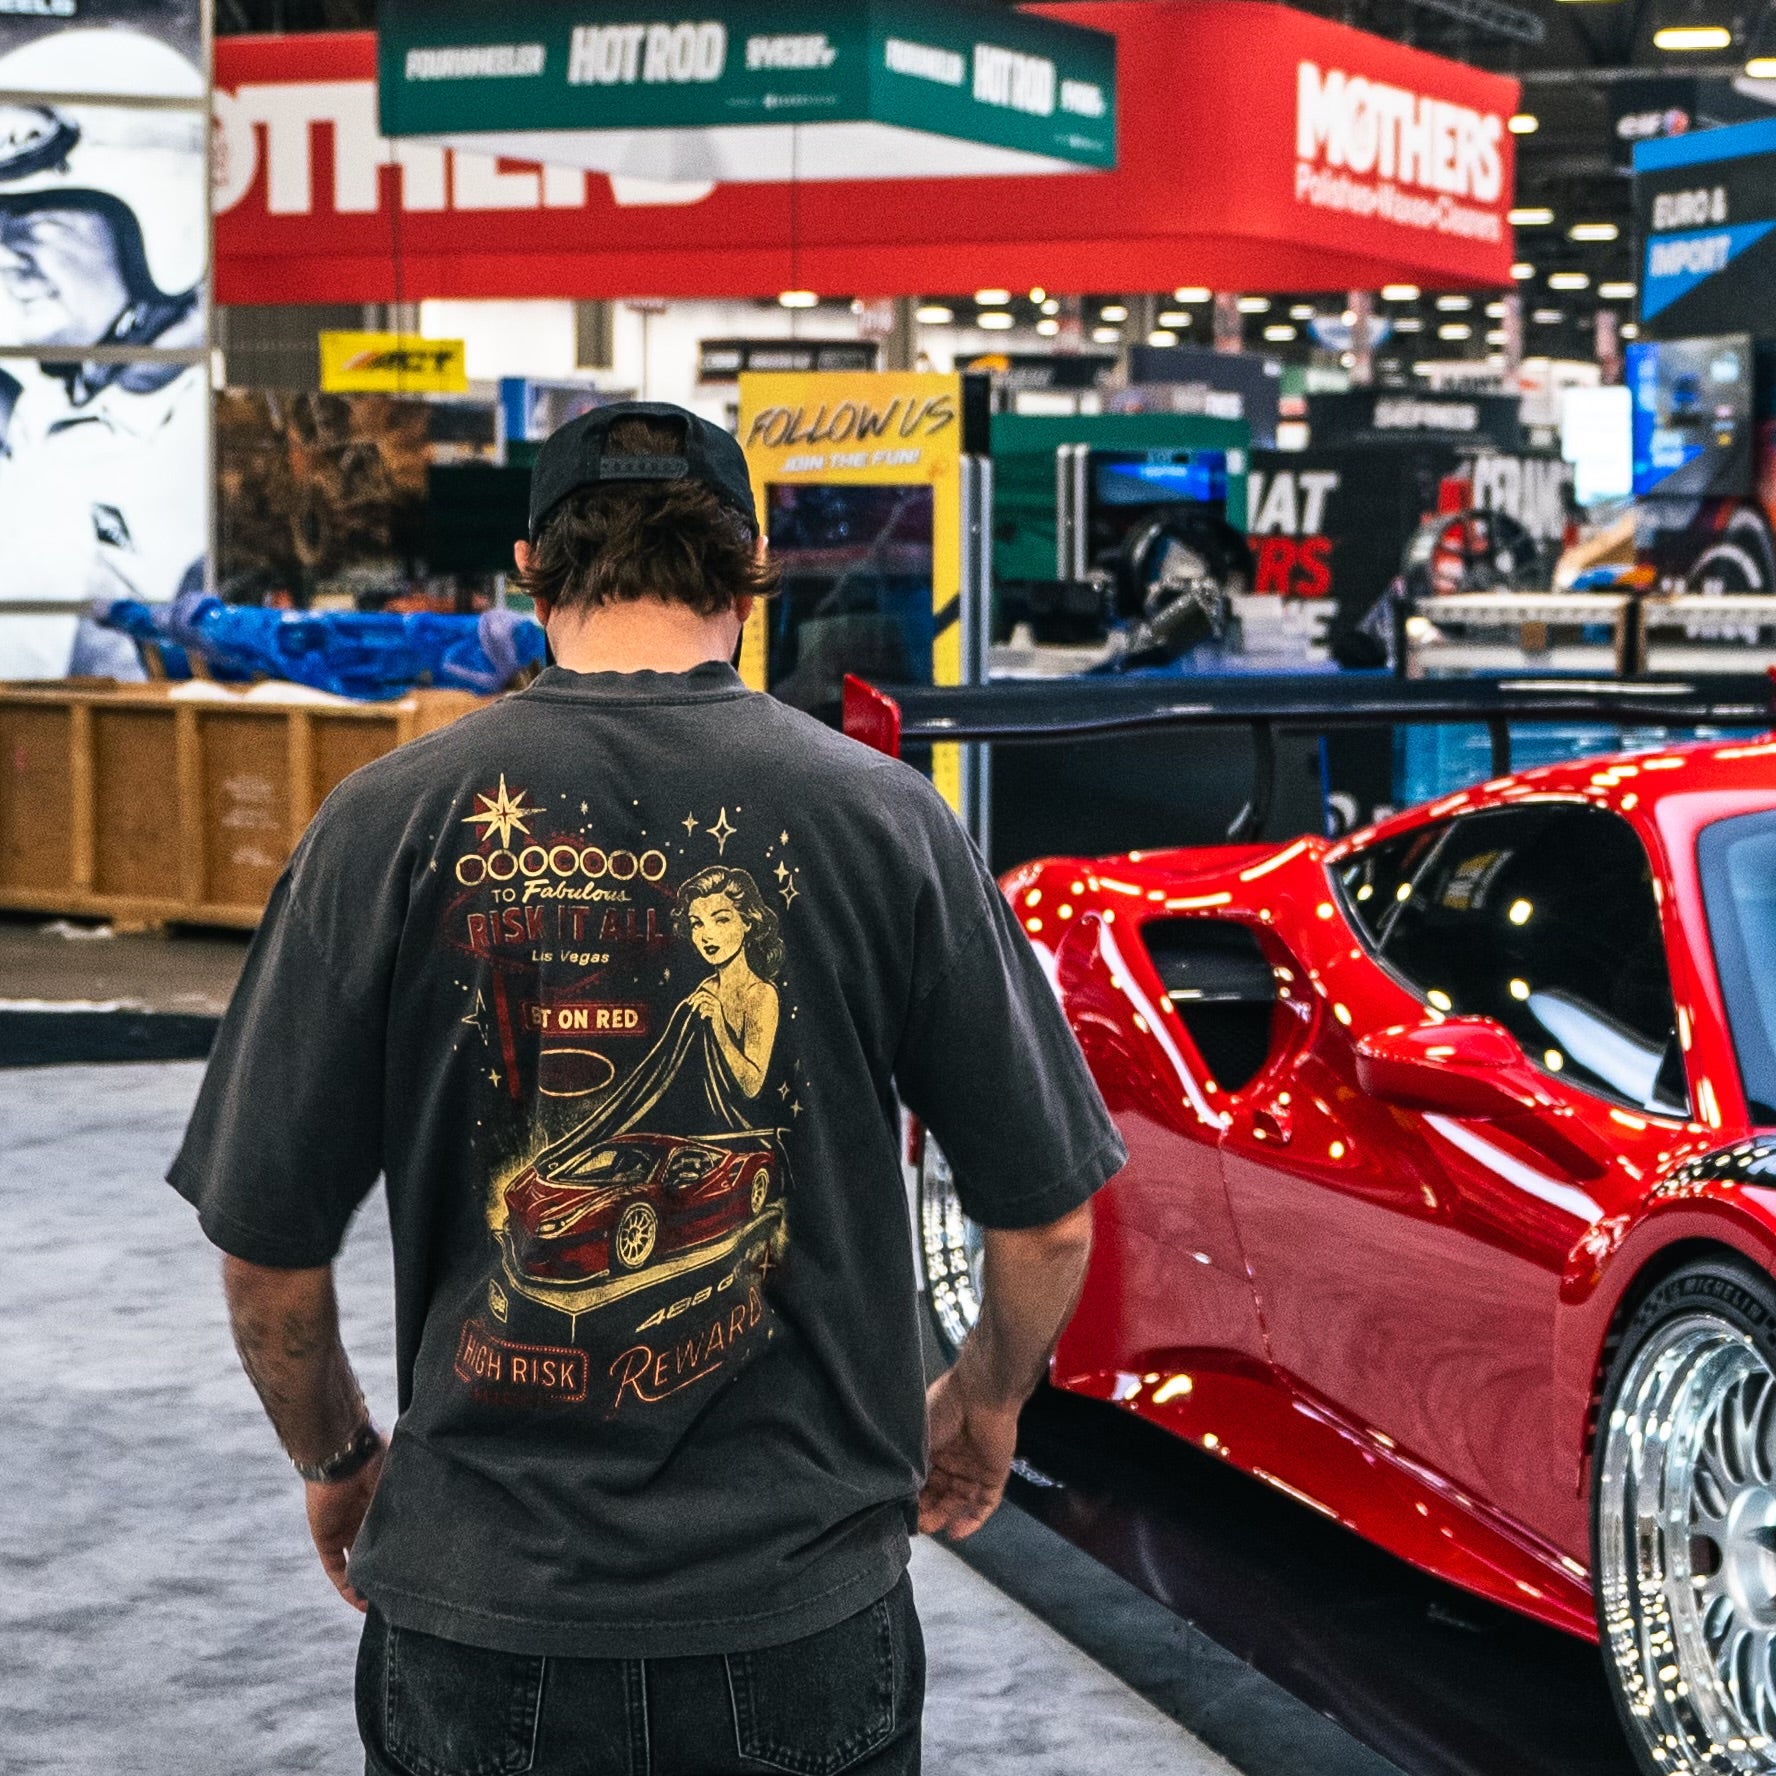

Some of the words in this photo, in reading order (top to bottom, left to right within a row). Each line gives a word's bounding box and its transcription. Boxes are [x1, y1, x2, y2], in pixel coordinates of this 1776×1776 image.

[567, 23, 646, 86] HOT
[643, 20, 727, 84] ROD
[1297, 59, 1502, 203] MOTHERS
[746, 395, 899, 449] FOLLOW
[899, 393, 956, 439] US
[780, 454, 825, 473] JOIN
[829, 451, 868, 470] THE
[872, 448, 921, 467] FUN!
[491, 888, 516, 903] TO
[521, 879, 632, 904] Fabulous
[467, 904, 546, 952] RISK
[558, 904, 591, 942] IT
[599, 907, 664, 942] ALL
[560, 950, 611, 967] Vegas
[558, 1009, 588, 1030] ON
[596, 1008, 639, 1030] RED
[635, 1284, 713, 1334] 488
[1683, 1276, 1765, 1323] MICHELIN
[463, 1334, 501, 1382] HIGH
[512, 1356, 576, 1389] RISK
[610, 1286, 763, 1409] REWARD
